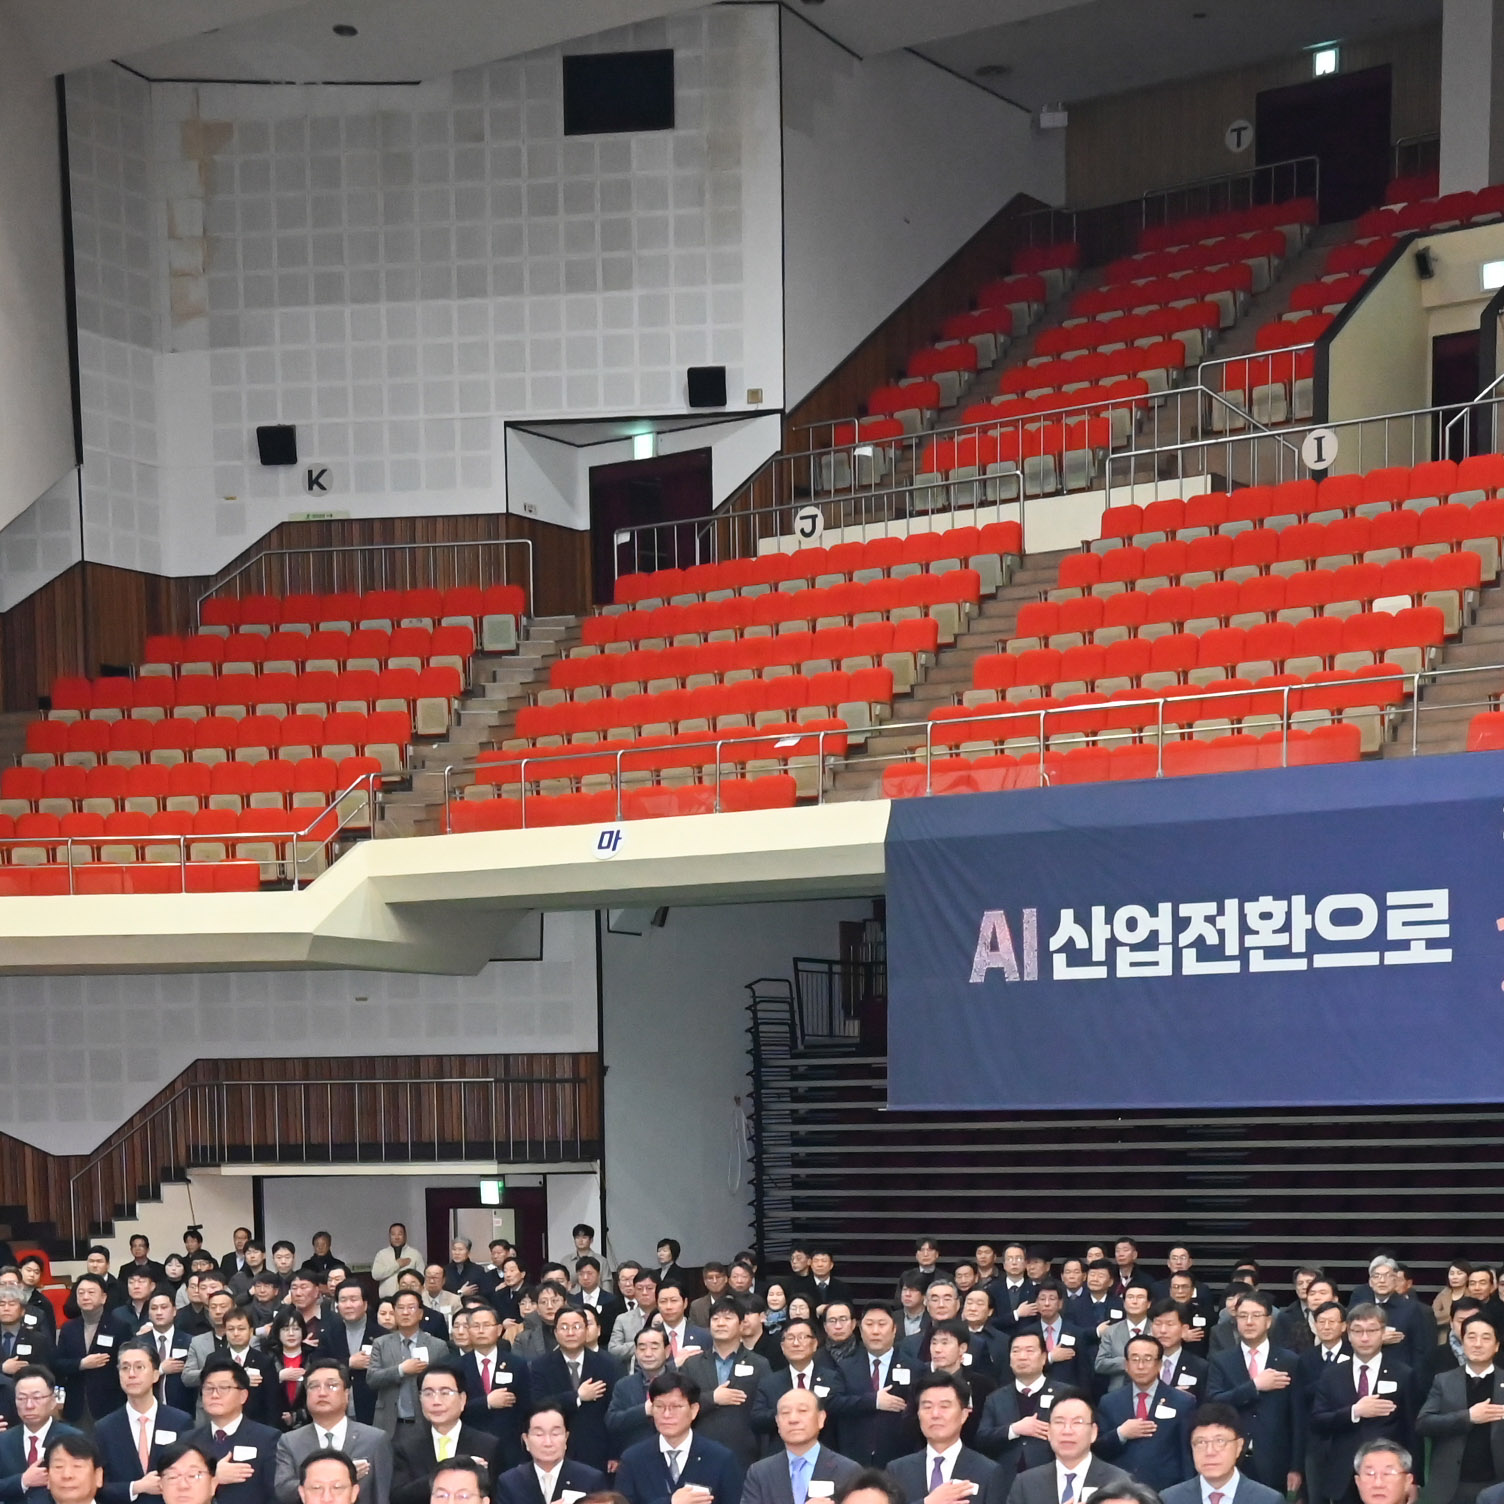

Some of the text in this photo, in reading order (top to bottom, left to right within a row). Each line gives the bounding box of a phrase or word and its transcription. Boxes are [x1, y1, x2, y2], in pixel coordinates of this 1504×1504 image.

[1230, 126, 1248, 149] T
[1313, 435, 1327, 464] I
[307, 468, 327, 492] K
[799, 513, 818, 539] J
[597, 829, 622, 852] 마
